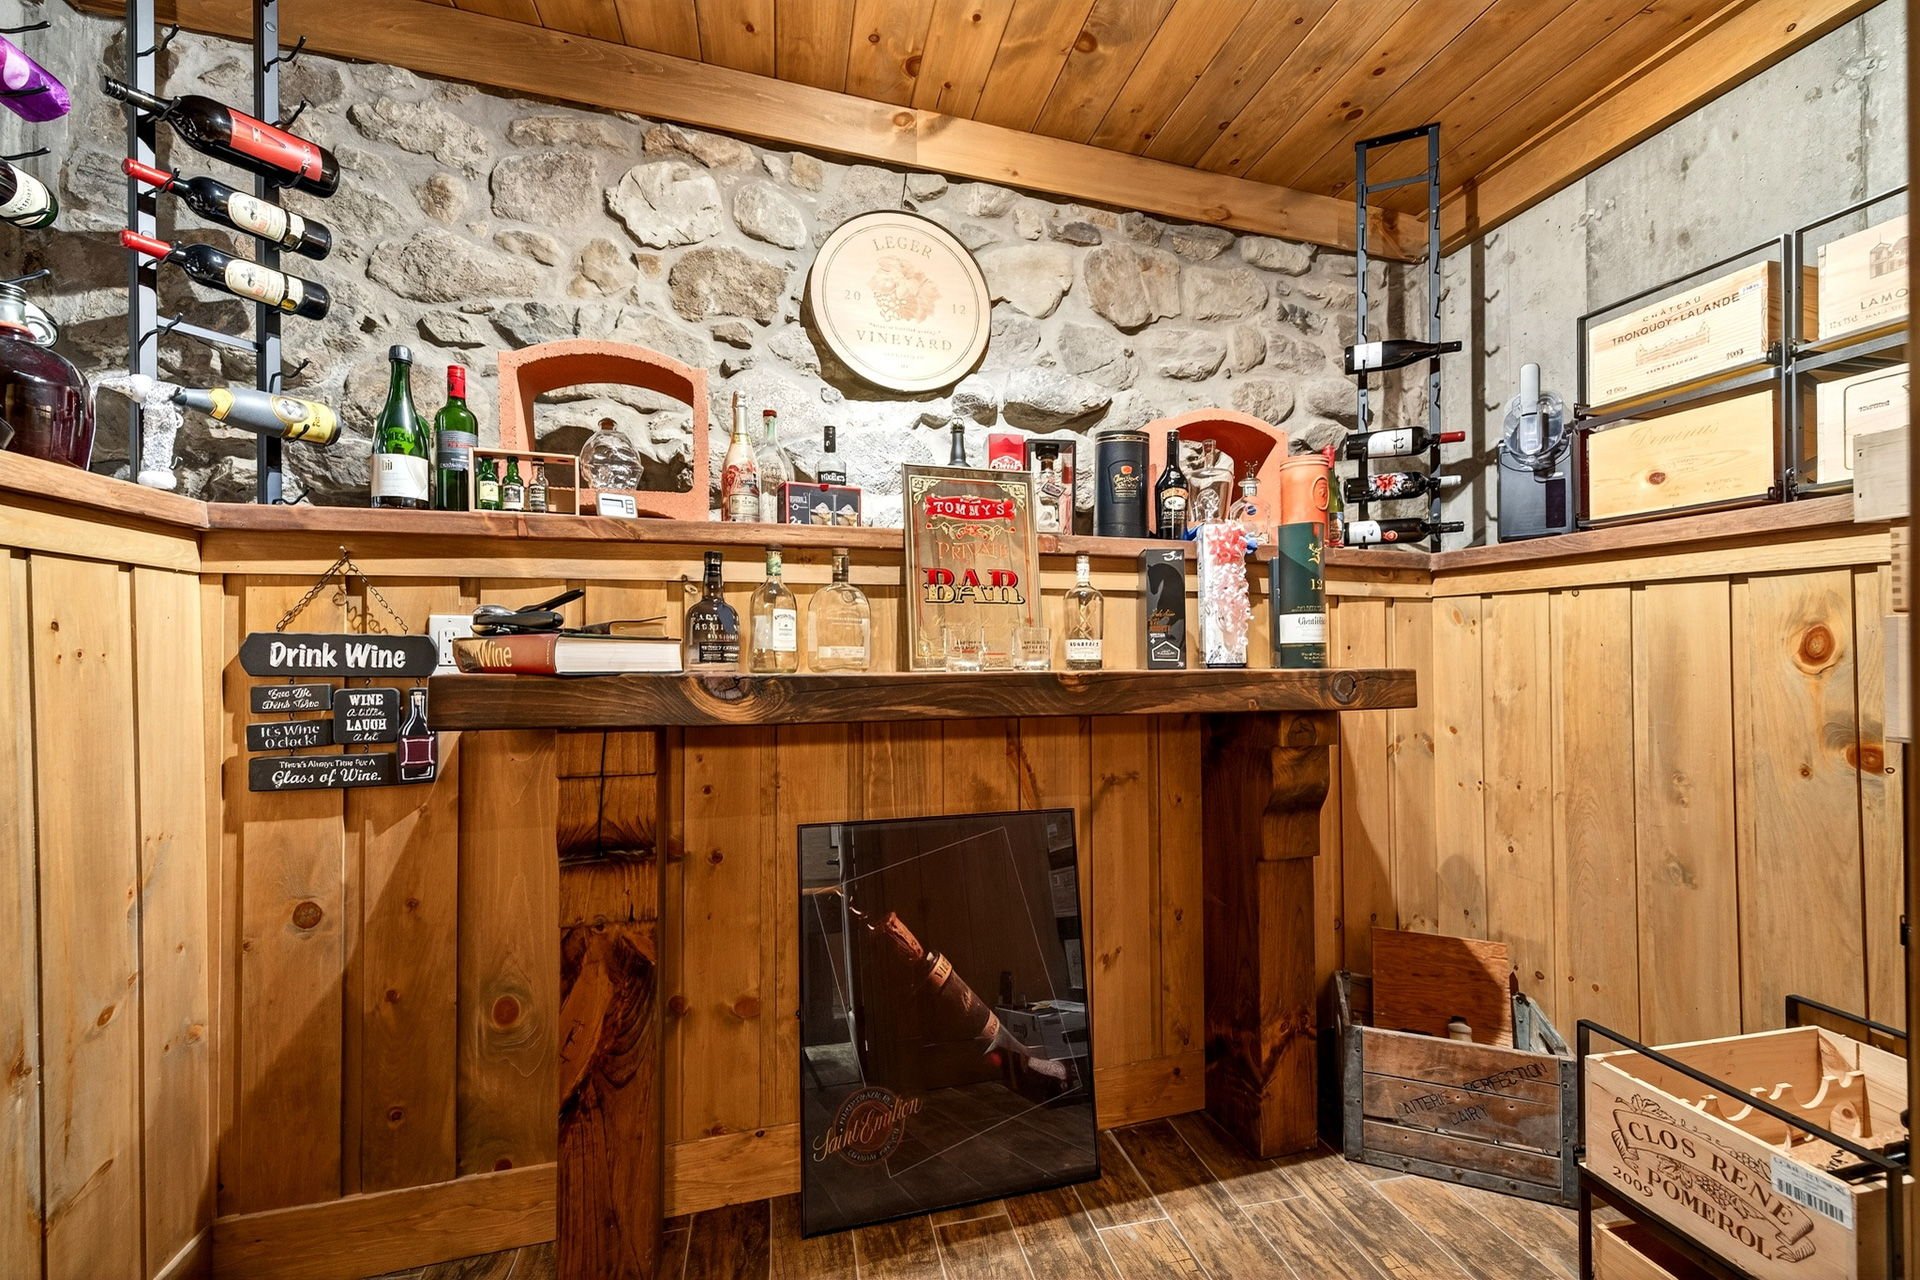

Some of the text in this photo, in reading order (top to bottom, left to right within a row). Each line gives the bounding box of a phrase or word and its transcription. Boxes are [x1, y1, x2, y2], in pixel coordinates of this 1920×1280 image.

[872, 235, 933, 260] LEGER
[856, 329, 953, 352] VINEYARD
[933, 501, 1005, 516] TOMMY'S
[923, 568, 1026, 605] BAR
[1311, 578, 1323, 590] 12
[269, 641, 406, 669] Drink Wine
[475, 639, 513, 667] Wine
[349, 694, 384, 707] WINE
[261, 724, 320, 738] It's Wine
[346, 719, 387, 731] LAUGH
[271, 768, 382, 789] Glass of Wine.
[1463, 1062, 1548, 1099] PERFECTION
[1450, 1103, 1489, 1126] DAIRY
[1628, 1121, 1696, 1159] CLOS
[1711, 1152, 1794, 1226] RENÉ
[1647, 1167, 1773, 1261] POMEROL
